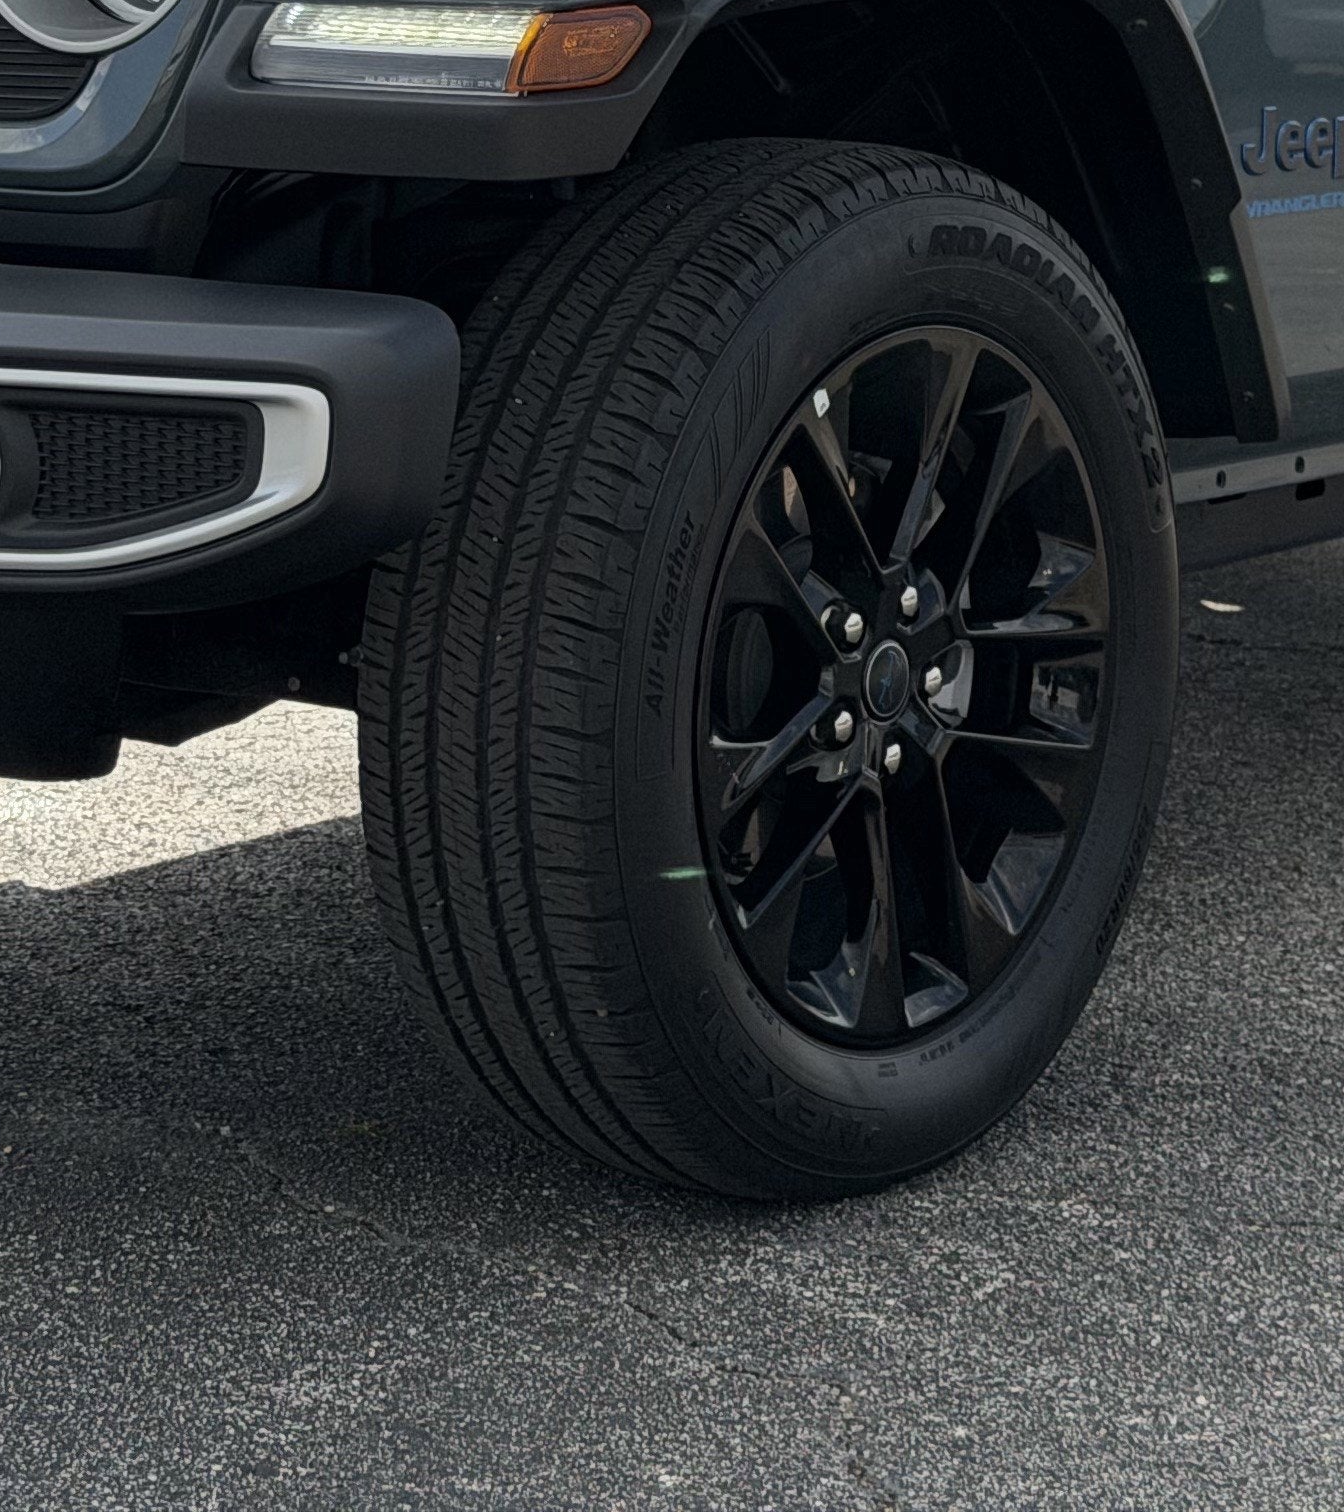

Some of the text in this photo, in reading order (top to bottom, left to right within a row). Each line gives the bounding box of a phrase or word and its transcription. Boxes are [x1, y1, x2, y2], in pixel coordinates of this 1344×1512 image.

[1247, 191, 1344, 219] WRANGLER
[927, 224, 1101, 334] ROADIAN
[645, 510, 696, 717] All-Weather
